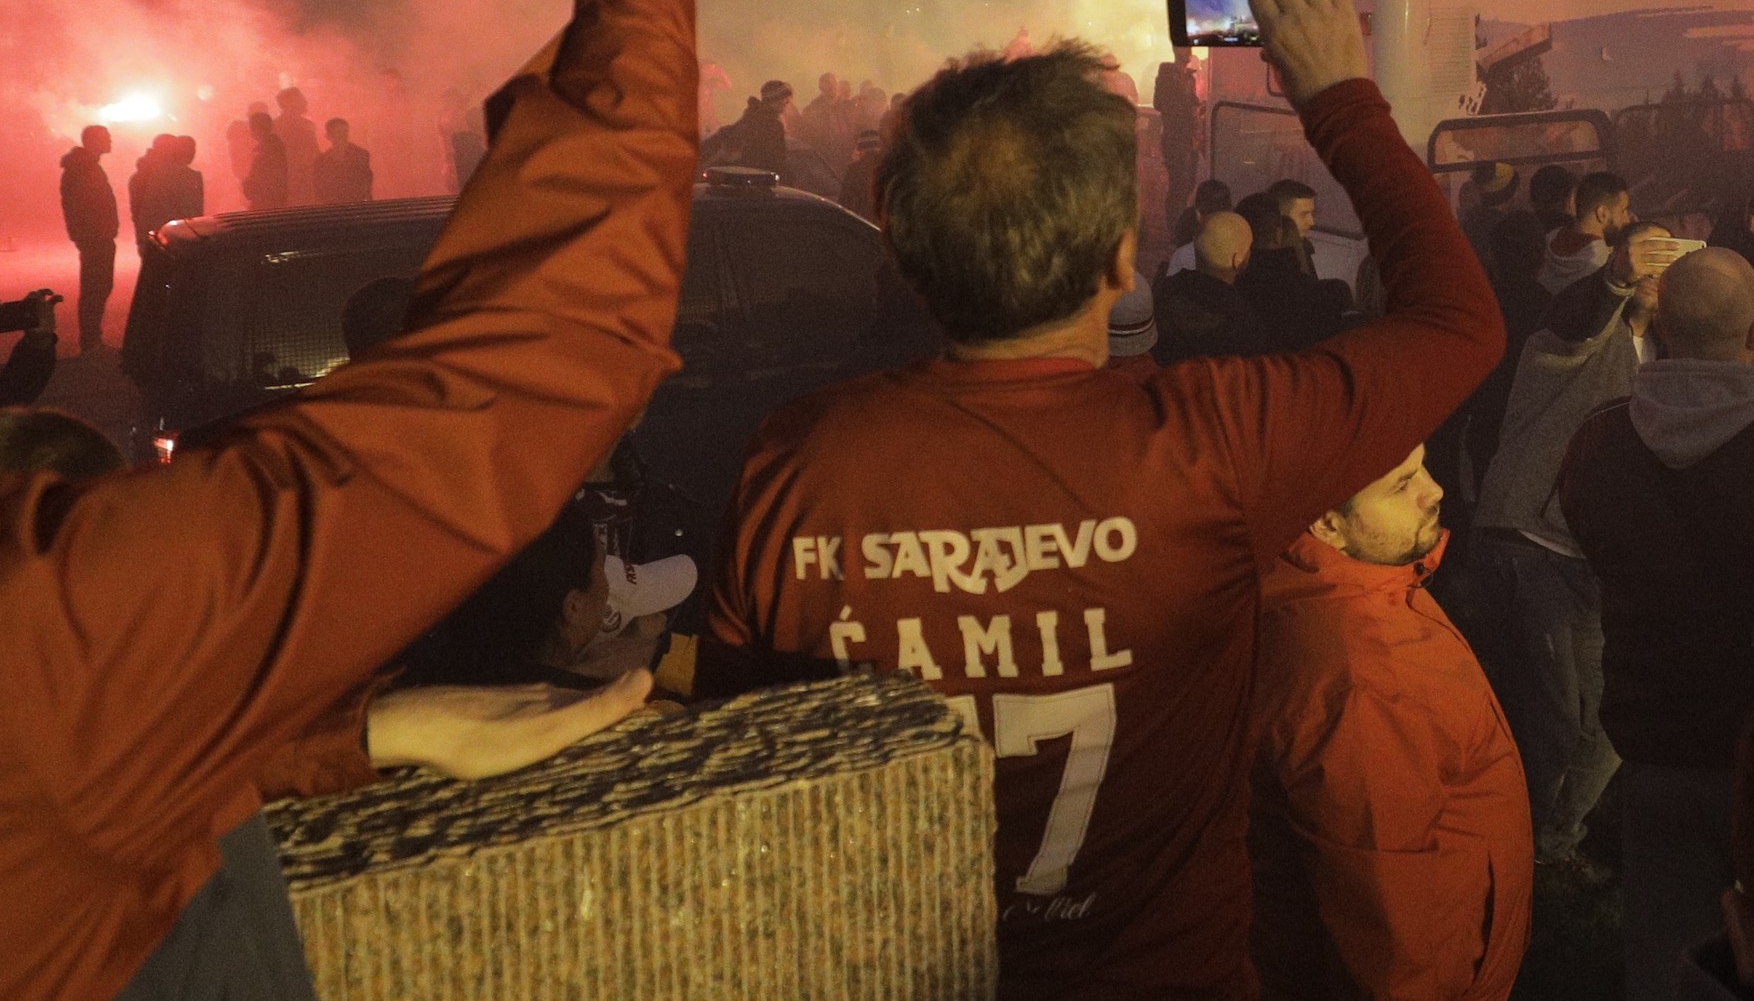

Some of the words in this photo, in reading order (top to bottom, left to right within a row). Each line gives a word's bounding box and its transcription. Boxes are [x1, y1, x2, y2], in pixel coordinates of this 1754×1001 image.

[792, 535, 843, 581] FK
[861, 515, 1137, 595] SARAJEVO
[829, 604, 1133, 682] ĆAMIL
[946, 682, 1116, 894] 7
